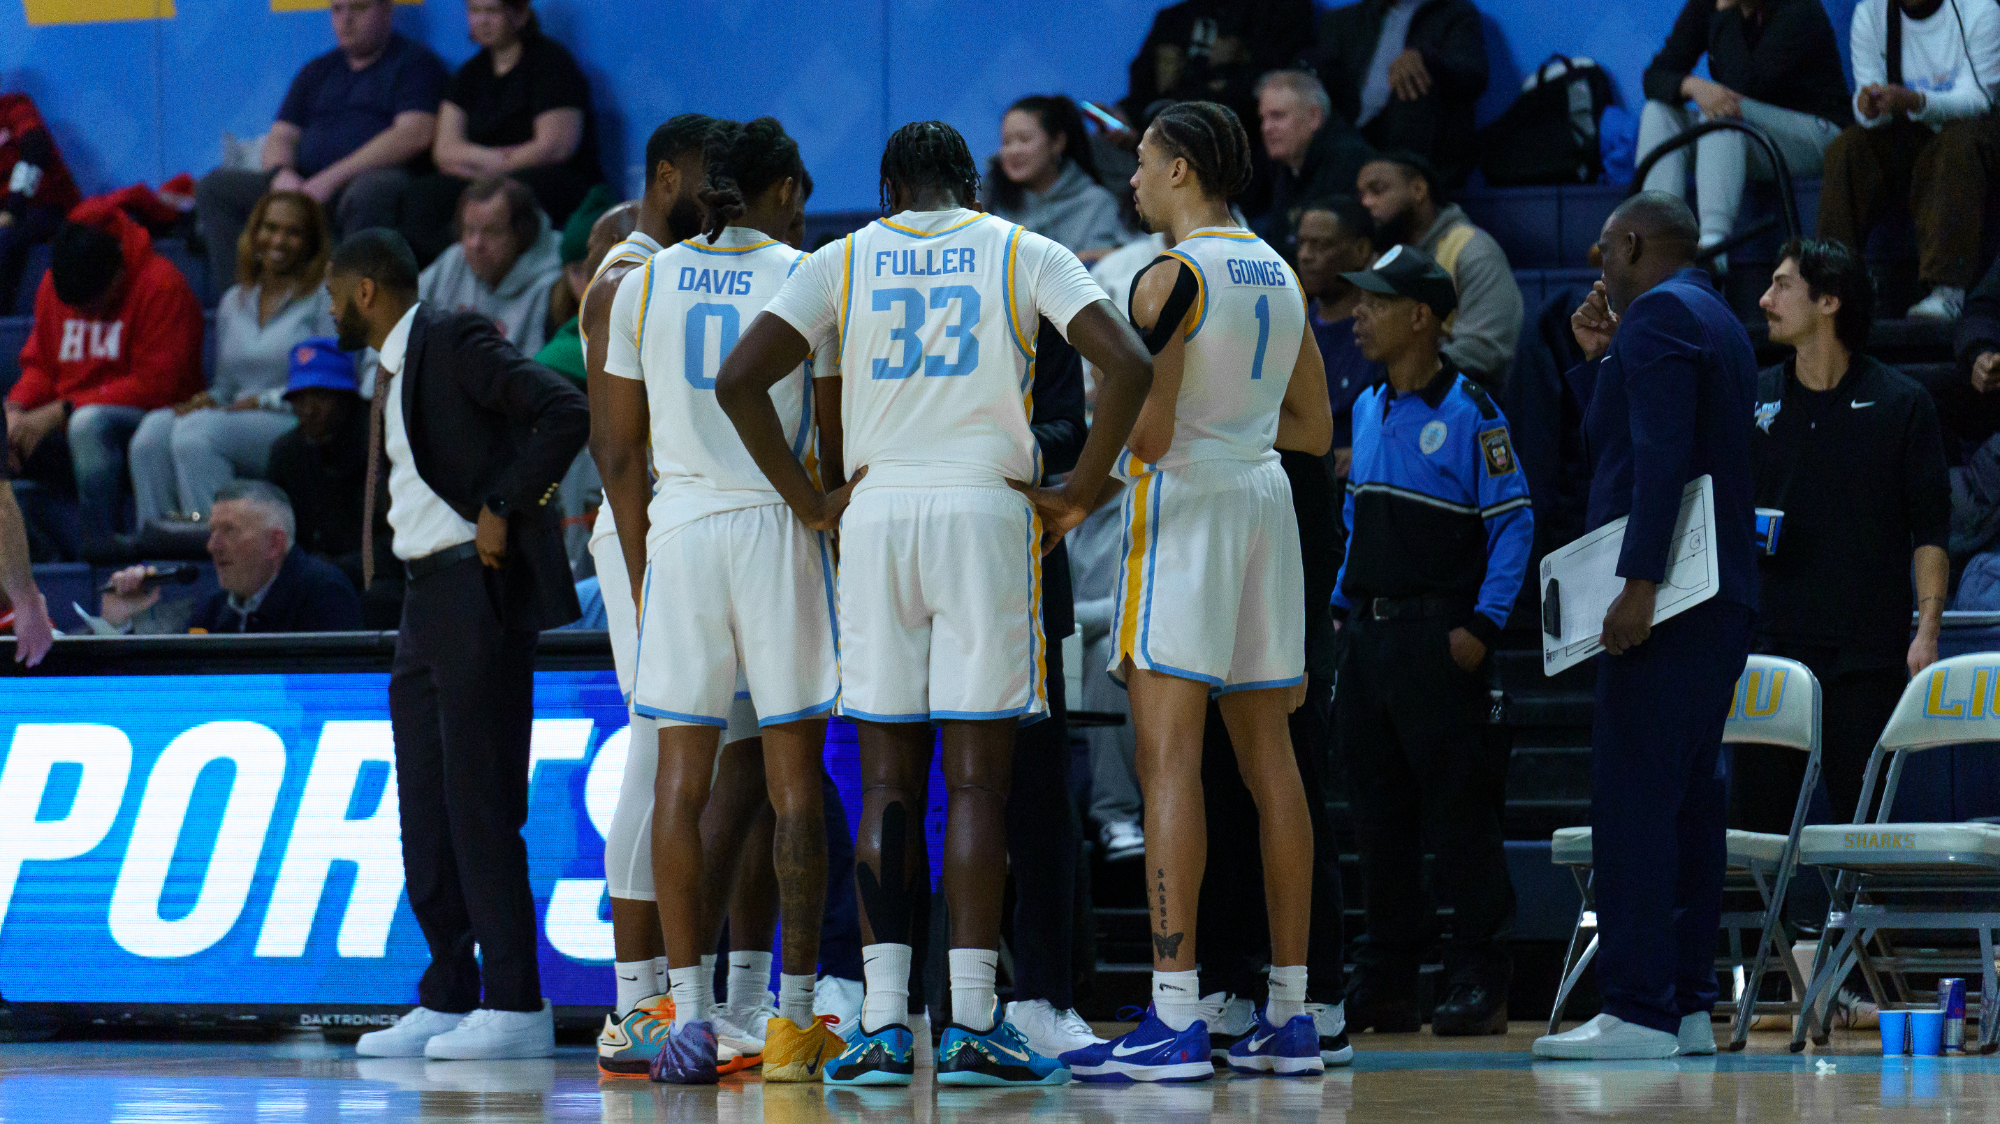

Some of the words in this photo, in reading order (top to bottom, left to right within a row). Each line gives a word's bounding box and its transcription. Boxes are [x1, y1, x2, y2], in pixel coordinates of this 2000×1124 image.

[678, 266, 753, 295] DAVIS
[876, 247, 975, 276] FULLER
[1226, 258, 1286, 287] GOINGS
[684, 302, 740, 390] 0
[872, 285, 981, 380] 33
[1250, 294, 1270, 380] 1
[1923, 666, 2000, 720] LI
[0, 719, 631, 961] POR
[1844, 832, 1915, 849] SHARKS
[300, 1014, 401, 1026] DAKTRONICS
